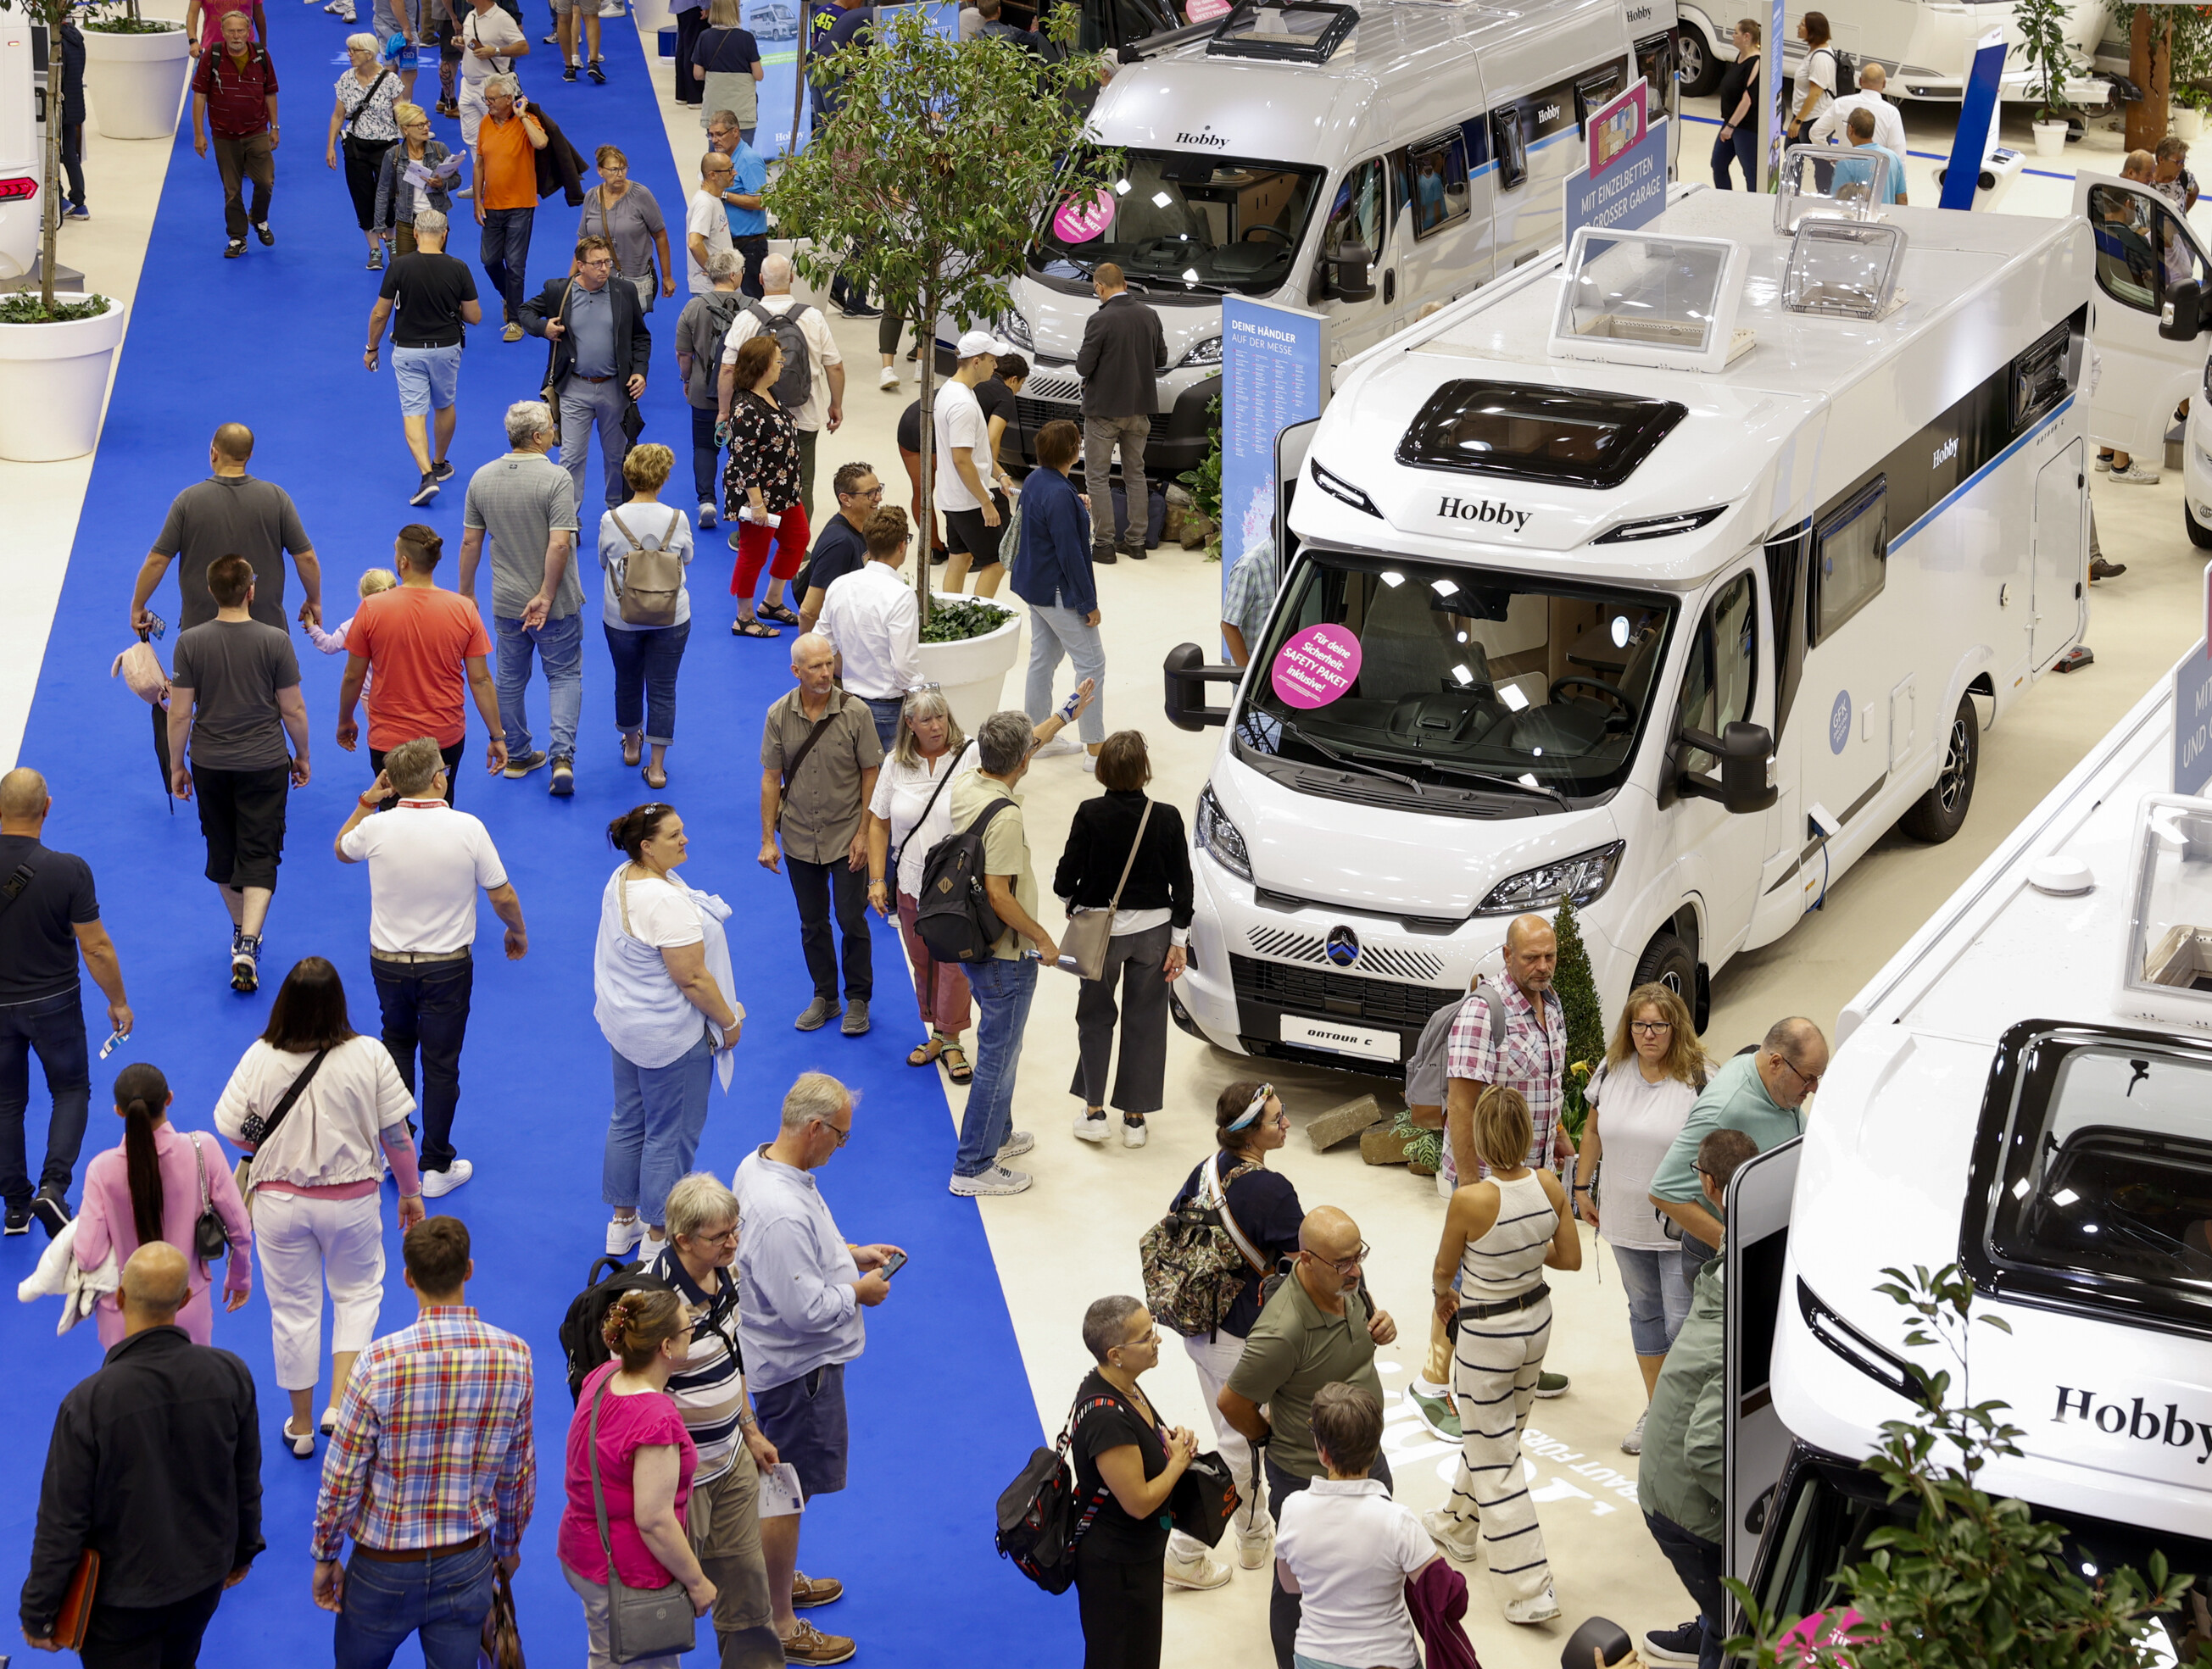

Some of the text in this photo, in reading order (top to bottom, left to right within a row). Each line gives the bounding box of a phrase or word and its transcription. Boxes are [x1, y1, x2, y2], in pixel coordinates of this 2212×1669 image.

[814, 12, 837, 31] 46
[1626, 6, 1652, 23] Hobby
[1538, 104, 1560, 124] Hobby
[1175, 133, 1231, 149] Hobby
[1581, 154, 1653, 216] MIT EINZELBETTEN
[1593, 197, 1628, 228] GROSSER
[1630, 175, 1661, 210] GARAGE
[1232, 320, 1296, 343] DEINE HÄNDLER
[1232, 333, 1293, 356] AUF DER MESSE
[1933, 437, 1959, 469] Hobby
[1437, 496, 1533, 533] Hobby
[1302, 642, 1345, 672] Sicherheit:
[1313, 632, 1351, 659] Für deine
[1283, 648, 1348, 688] SAFETY PAKET
[1286, 665, 1326, 693] inklusive!
[1833, 698, 1846, 728] GFK
[2183, 724, 2206, 768] UND
[1307, 1029, 1358, 1044] ONTOUR
[2050, 1385, 2212, 1465] Hobby
